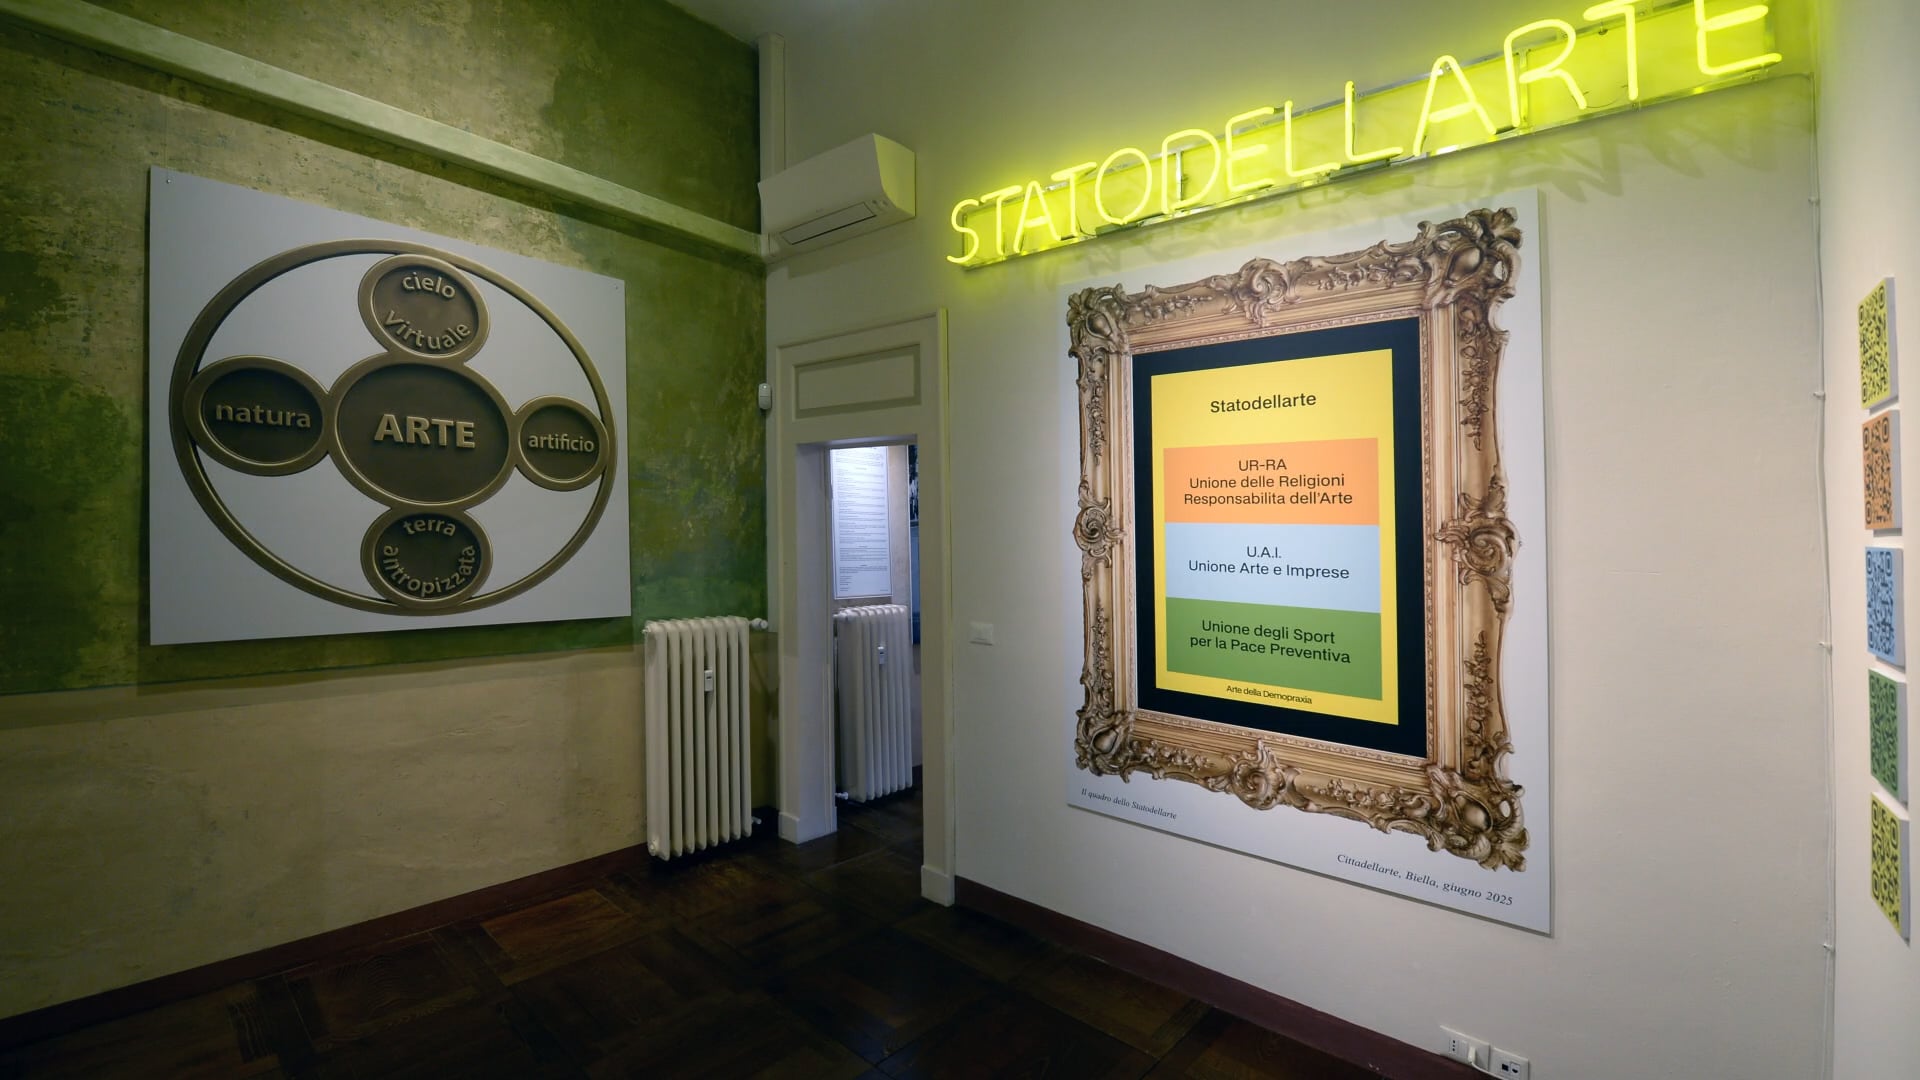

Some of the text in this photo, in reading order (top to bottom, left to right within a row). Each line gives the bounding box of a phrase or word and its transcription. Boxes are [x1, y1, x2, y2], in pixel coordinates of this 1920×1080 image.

[946, 0, 1782, 264] STATODELLARTE
[402, 272, 456, 298] cielo
[1210, 393, 1317, 413] Statodellarte
[215, 402, 311, 428] natura
[374, 413, 476, 449] ARTE
[527, 432, 595, 454] artificio
[1238, 459, 1287, 471] UR-RA
[1189, 474, 1345, 489] Unione delle Religioni
[1184, 493, 1286, 506] Responsabilita
[403, 518, 457, 537] terra
[1246, 546, 1282, 558] U.A.I.
[383, 544, 476, 598] antropizzata
[1188, 560, 1350, 579] Unione Arte e Imprese
[1202, 620, 1335, 644] Unione degli Sport
[1190, 636, 1351, 663] per la Pace Preventiva
[1226, 685, 1312, 704] Arte della Demopraxia
[1088, 791, 1111, 802] quadro
[1113, 796, 1130, 807] dello
[1132, 801, 1177, 819] Statodellarte
[1442, 882, 1482, 898] giugno
[1485, 891, 1513, 906] 2025
